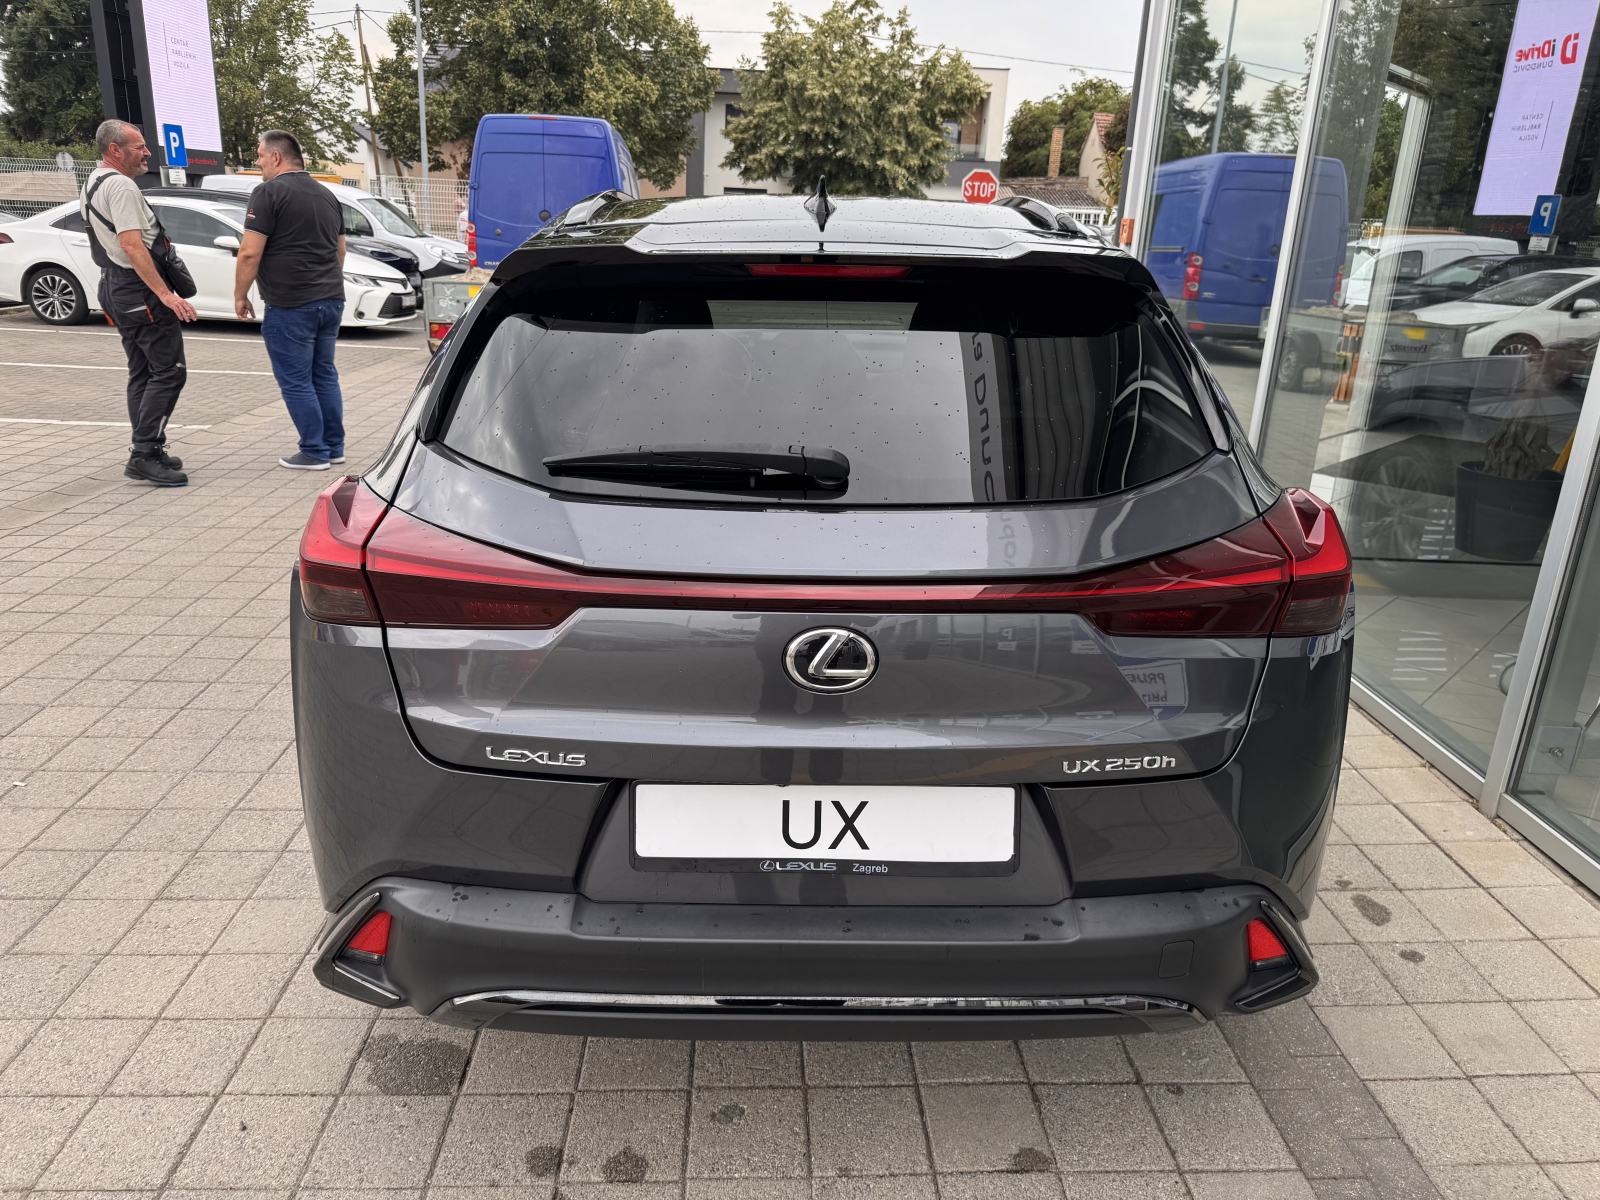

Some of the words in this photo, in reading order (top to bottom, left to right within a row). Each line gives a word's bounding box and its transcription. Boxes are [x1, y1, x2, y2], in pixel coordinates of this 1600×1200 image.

[169, 131, 180, 159] P
[964, 181, 996, 198] STOP
[485, 746, 588, 767] LEXUS
[1062, 759, 1102, 774] UX
[1105, 756, 1176, 771] 250h
[782, 800, 870, 850] UX
[775, 861, 837, 871] LEXUS
[852, 863, 889, 874] Zagreb
